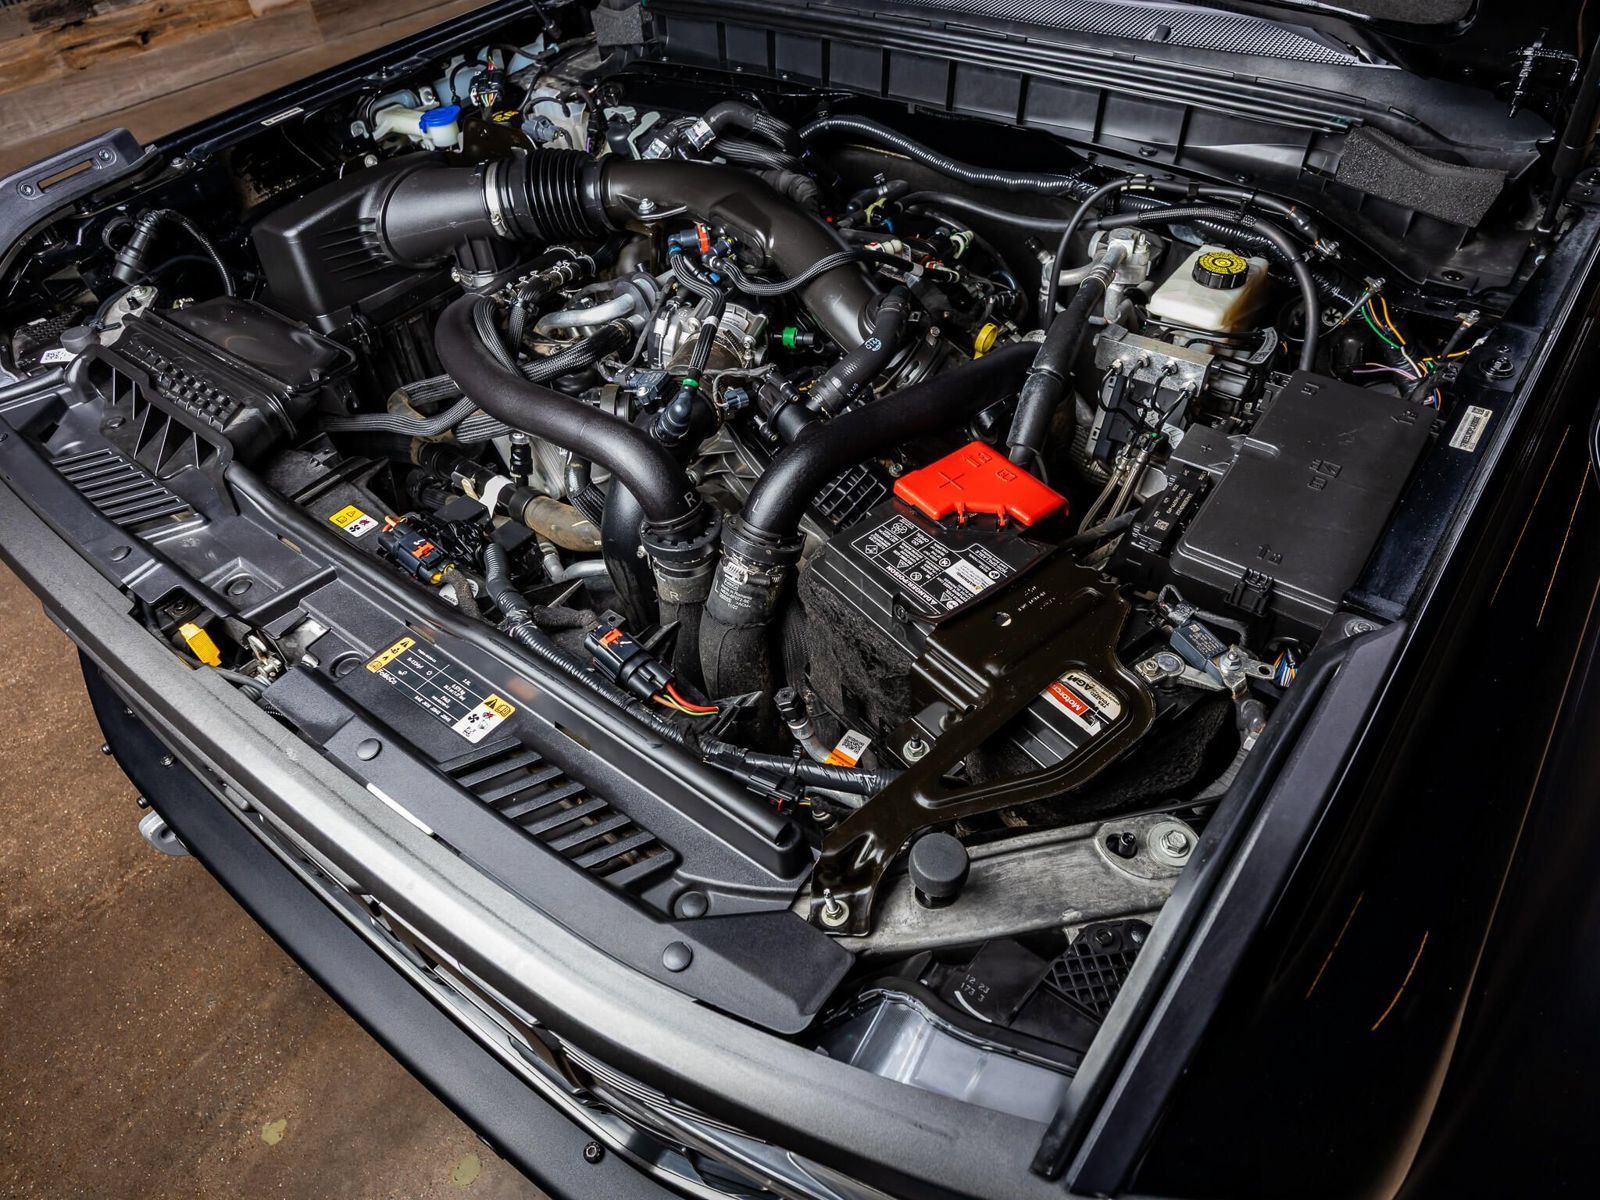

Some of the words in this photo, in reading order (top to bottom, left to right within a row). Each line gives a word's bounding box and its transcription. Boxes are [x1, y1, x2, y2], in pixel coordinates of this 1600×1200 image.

[684, 491, 696, 508] R
[886, 565, 932, 601] DANGER/POISON
[376, 669, 398, 685] FoMoCo
[1067, 675, 1094, 690] AGM
[1049, 683, 1083, 711] Motorcr
[965, 974, 976, 984] 12
